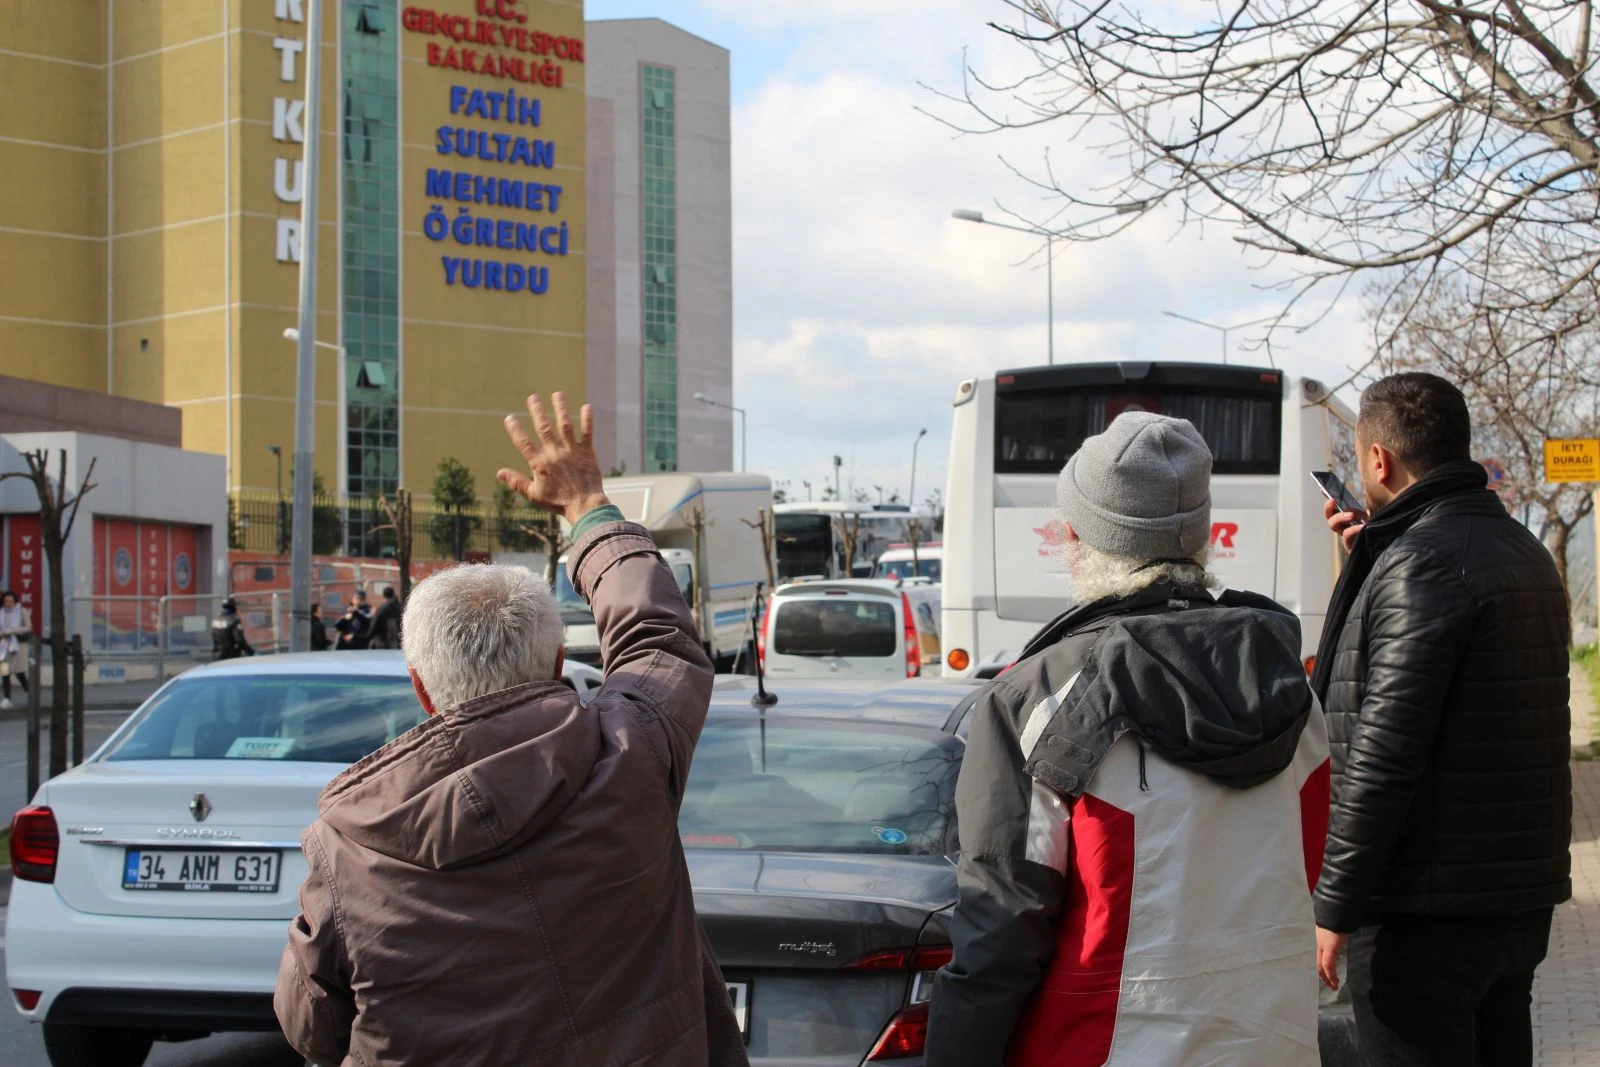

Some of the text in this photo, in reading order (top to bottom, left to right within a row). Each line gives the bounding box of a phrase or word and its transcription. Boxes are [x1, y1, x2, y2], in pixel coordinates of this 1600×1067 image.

[501, 25, 529, 52] VE
[531, 31, 585, 62] SPOR
[427, 42, 564, 87] BAKANLIĞI
[450, 86, 541, 125] FATİH
[437, 126, 555, 168] SULTAN
[426, 168, 563, 212] MEHMET
[424, 205, 569, 255] ÖĞRENCİ
[443, 256, 549, 294] YURDU
[156, 827, 241, 839] SYMBOL
[140, 855, 273, 882] 34 ANM 631
